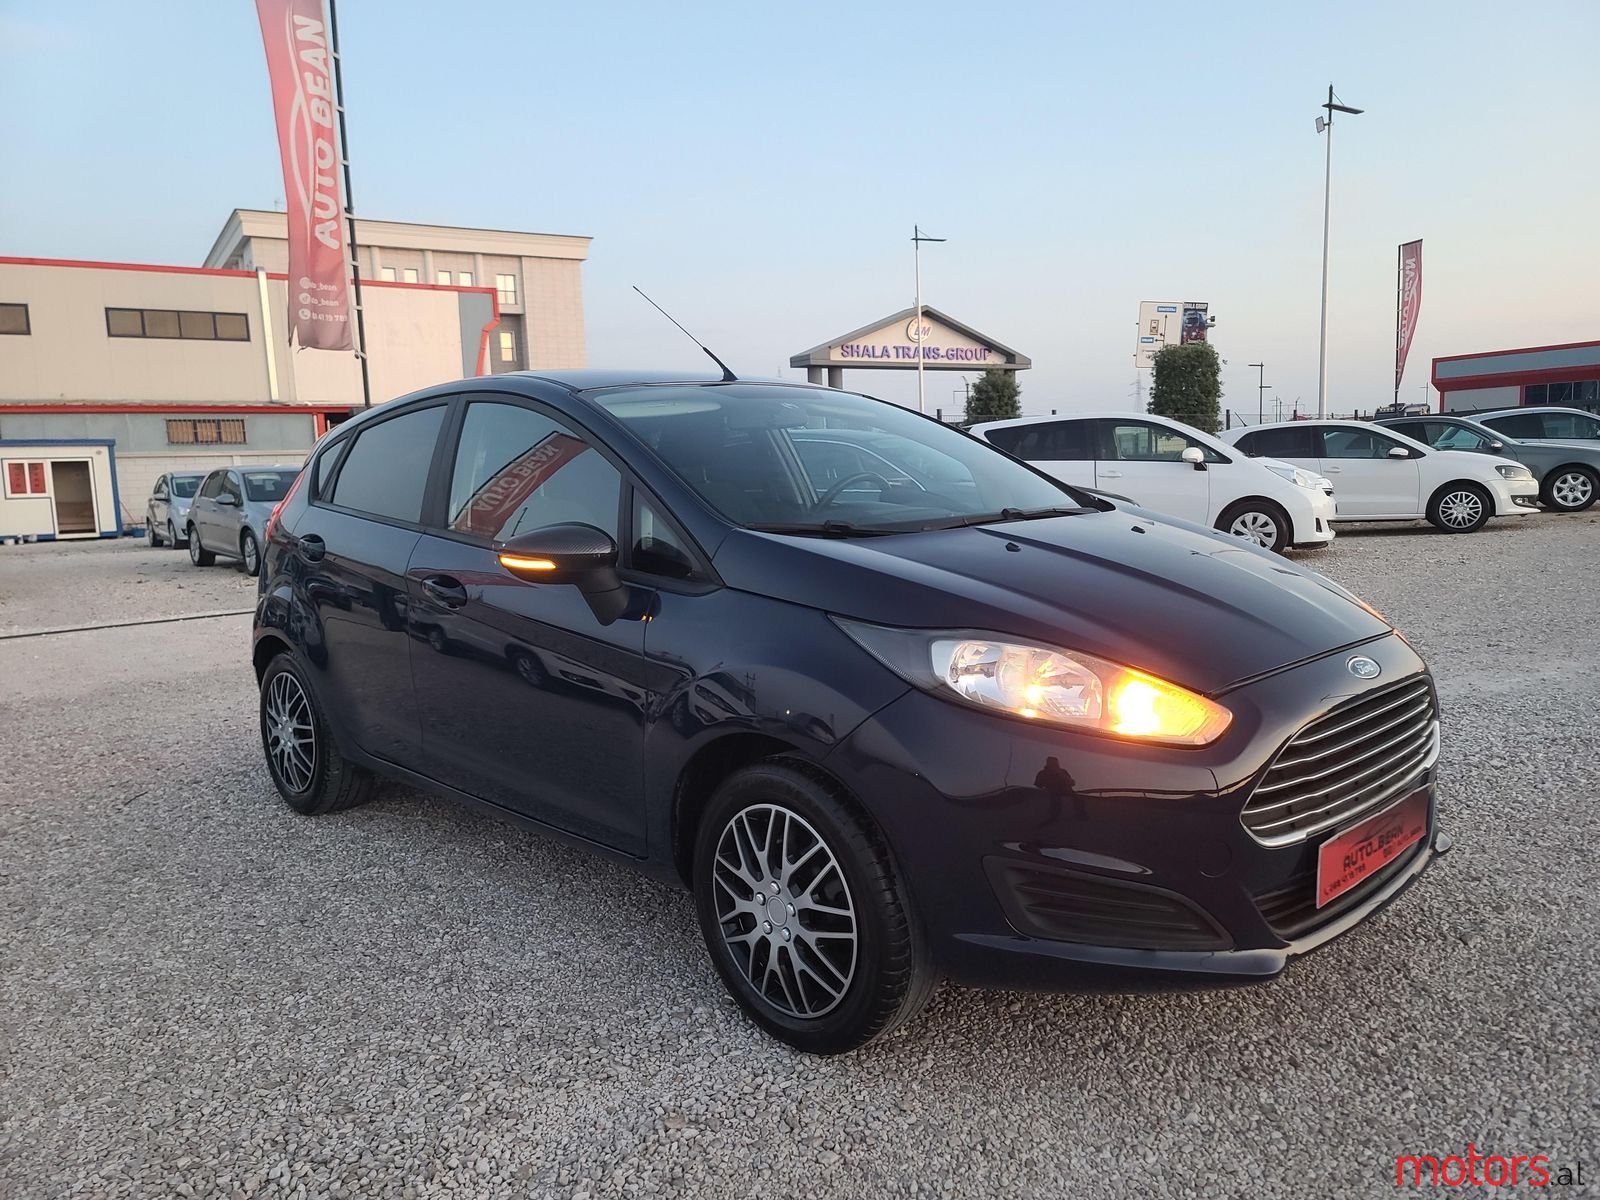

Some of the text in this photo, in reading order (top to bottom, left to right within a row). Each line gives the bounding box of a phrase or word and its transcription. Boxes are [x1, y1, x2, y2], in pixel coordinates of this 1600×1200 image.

[293, 14, 341, 250] AUTO BEAN
[840, 344, 890, 359] SHALA
